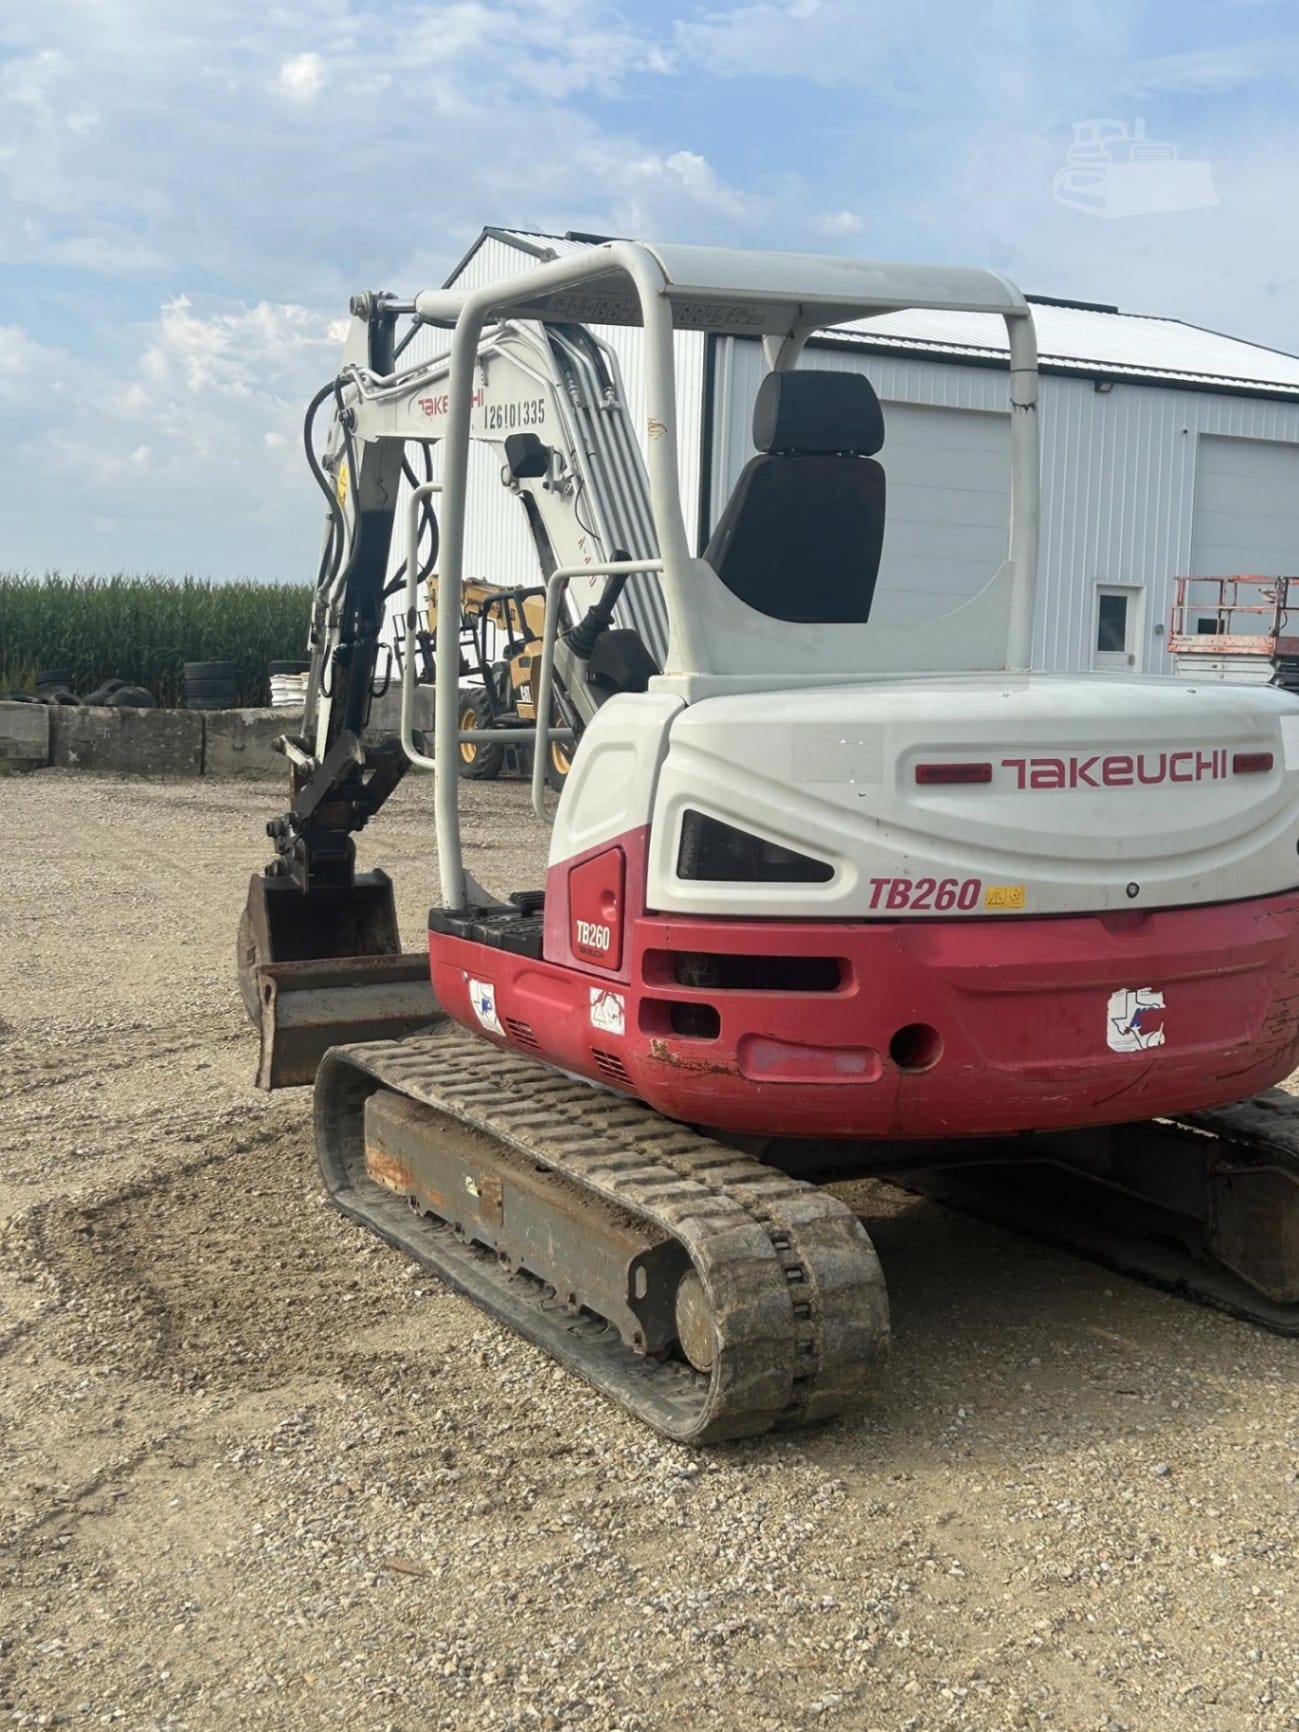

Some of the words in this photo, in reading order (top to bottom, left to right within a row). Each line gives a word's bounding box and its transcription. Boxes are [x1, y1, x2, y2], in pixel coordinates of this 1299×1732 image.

[1001, 750, 1227, 789] TAKEUCHI
[869, 878, 982, 911] TB260
[577, 920, 610, 951] TB260
